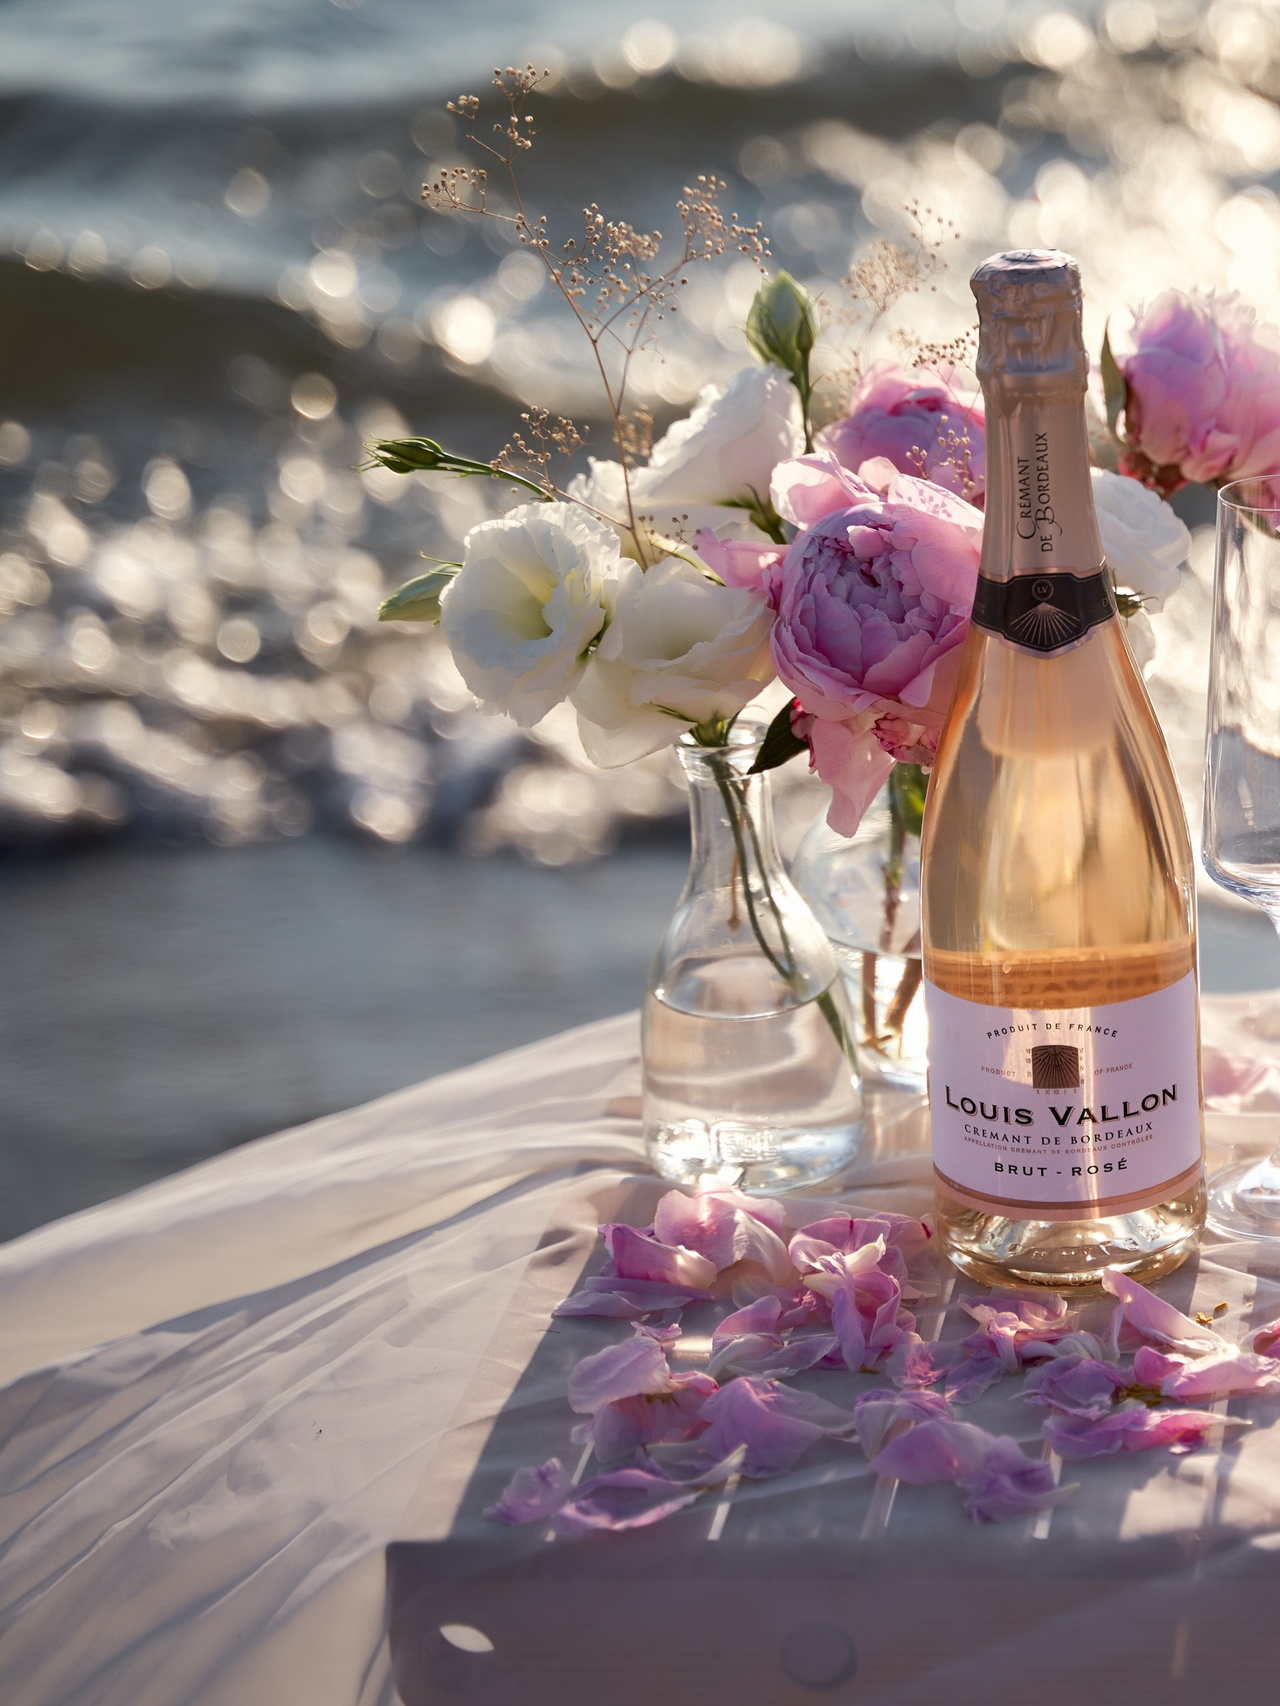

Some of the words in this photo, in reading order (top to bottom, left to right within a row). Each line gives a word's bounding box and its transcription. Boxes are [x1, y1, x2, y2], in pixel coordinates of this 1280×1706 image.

[1040, 533, 1054, 553] DE
[986, 1023, 1038, 1040] PRODUIT
[1045, 1023, 1062, 1031] DE
[1069, 1023, 1119, 1038] FRANCE
[980, 1065, 1017, 1078] PRODUCT
[1106, 1063, 1134, 1074] FRANCE
[945, 1085, 1035, 1127] LOUIS
[1048, 1084, 1178, 1128] VALLON
[964, 1124, 1032, 1145] CREMANT
[1041, 1136, 1062, 1146] DE
[1070, 1122, 1154, 1145] BORDEAUX
[964, 1136, 1008, 1152] APPELLATION
[1065, 1145, 1109, 1155] BORDEAUX
[994, 1162, 1048, 1178] BRUT
[1071, 1157, 1128, 1177] ROSÉ
